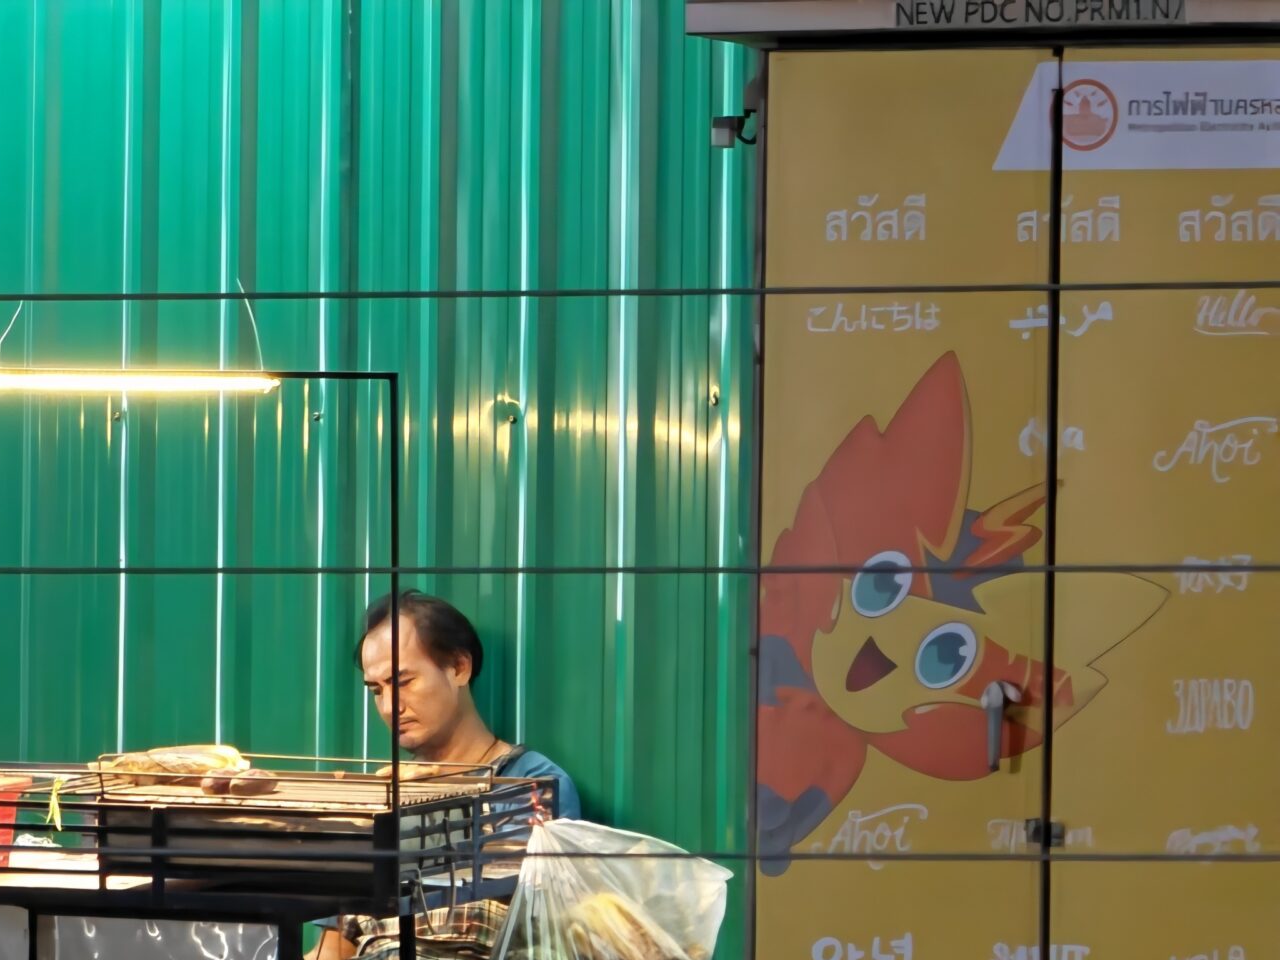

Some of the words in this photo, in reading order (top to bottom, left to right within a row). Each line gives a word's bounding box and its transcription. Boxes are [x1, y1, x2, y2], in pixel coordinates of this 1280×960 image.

[895, 0, 954, 26] NEW
[964, 0, 1017, 24] PDC
[825, 193, 926, 241] สวัสดี
[806, 301, 941, 332] こんにちは
